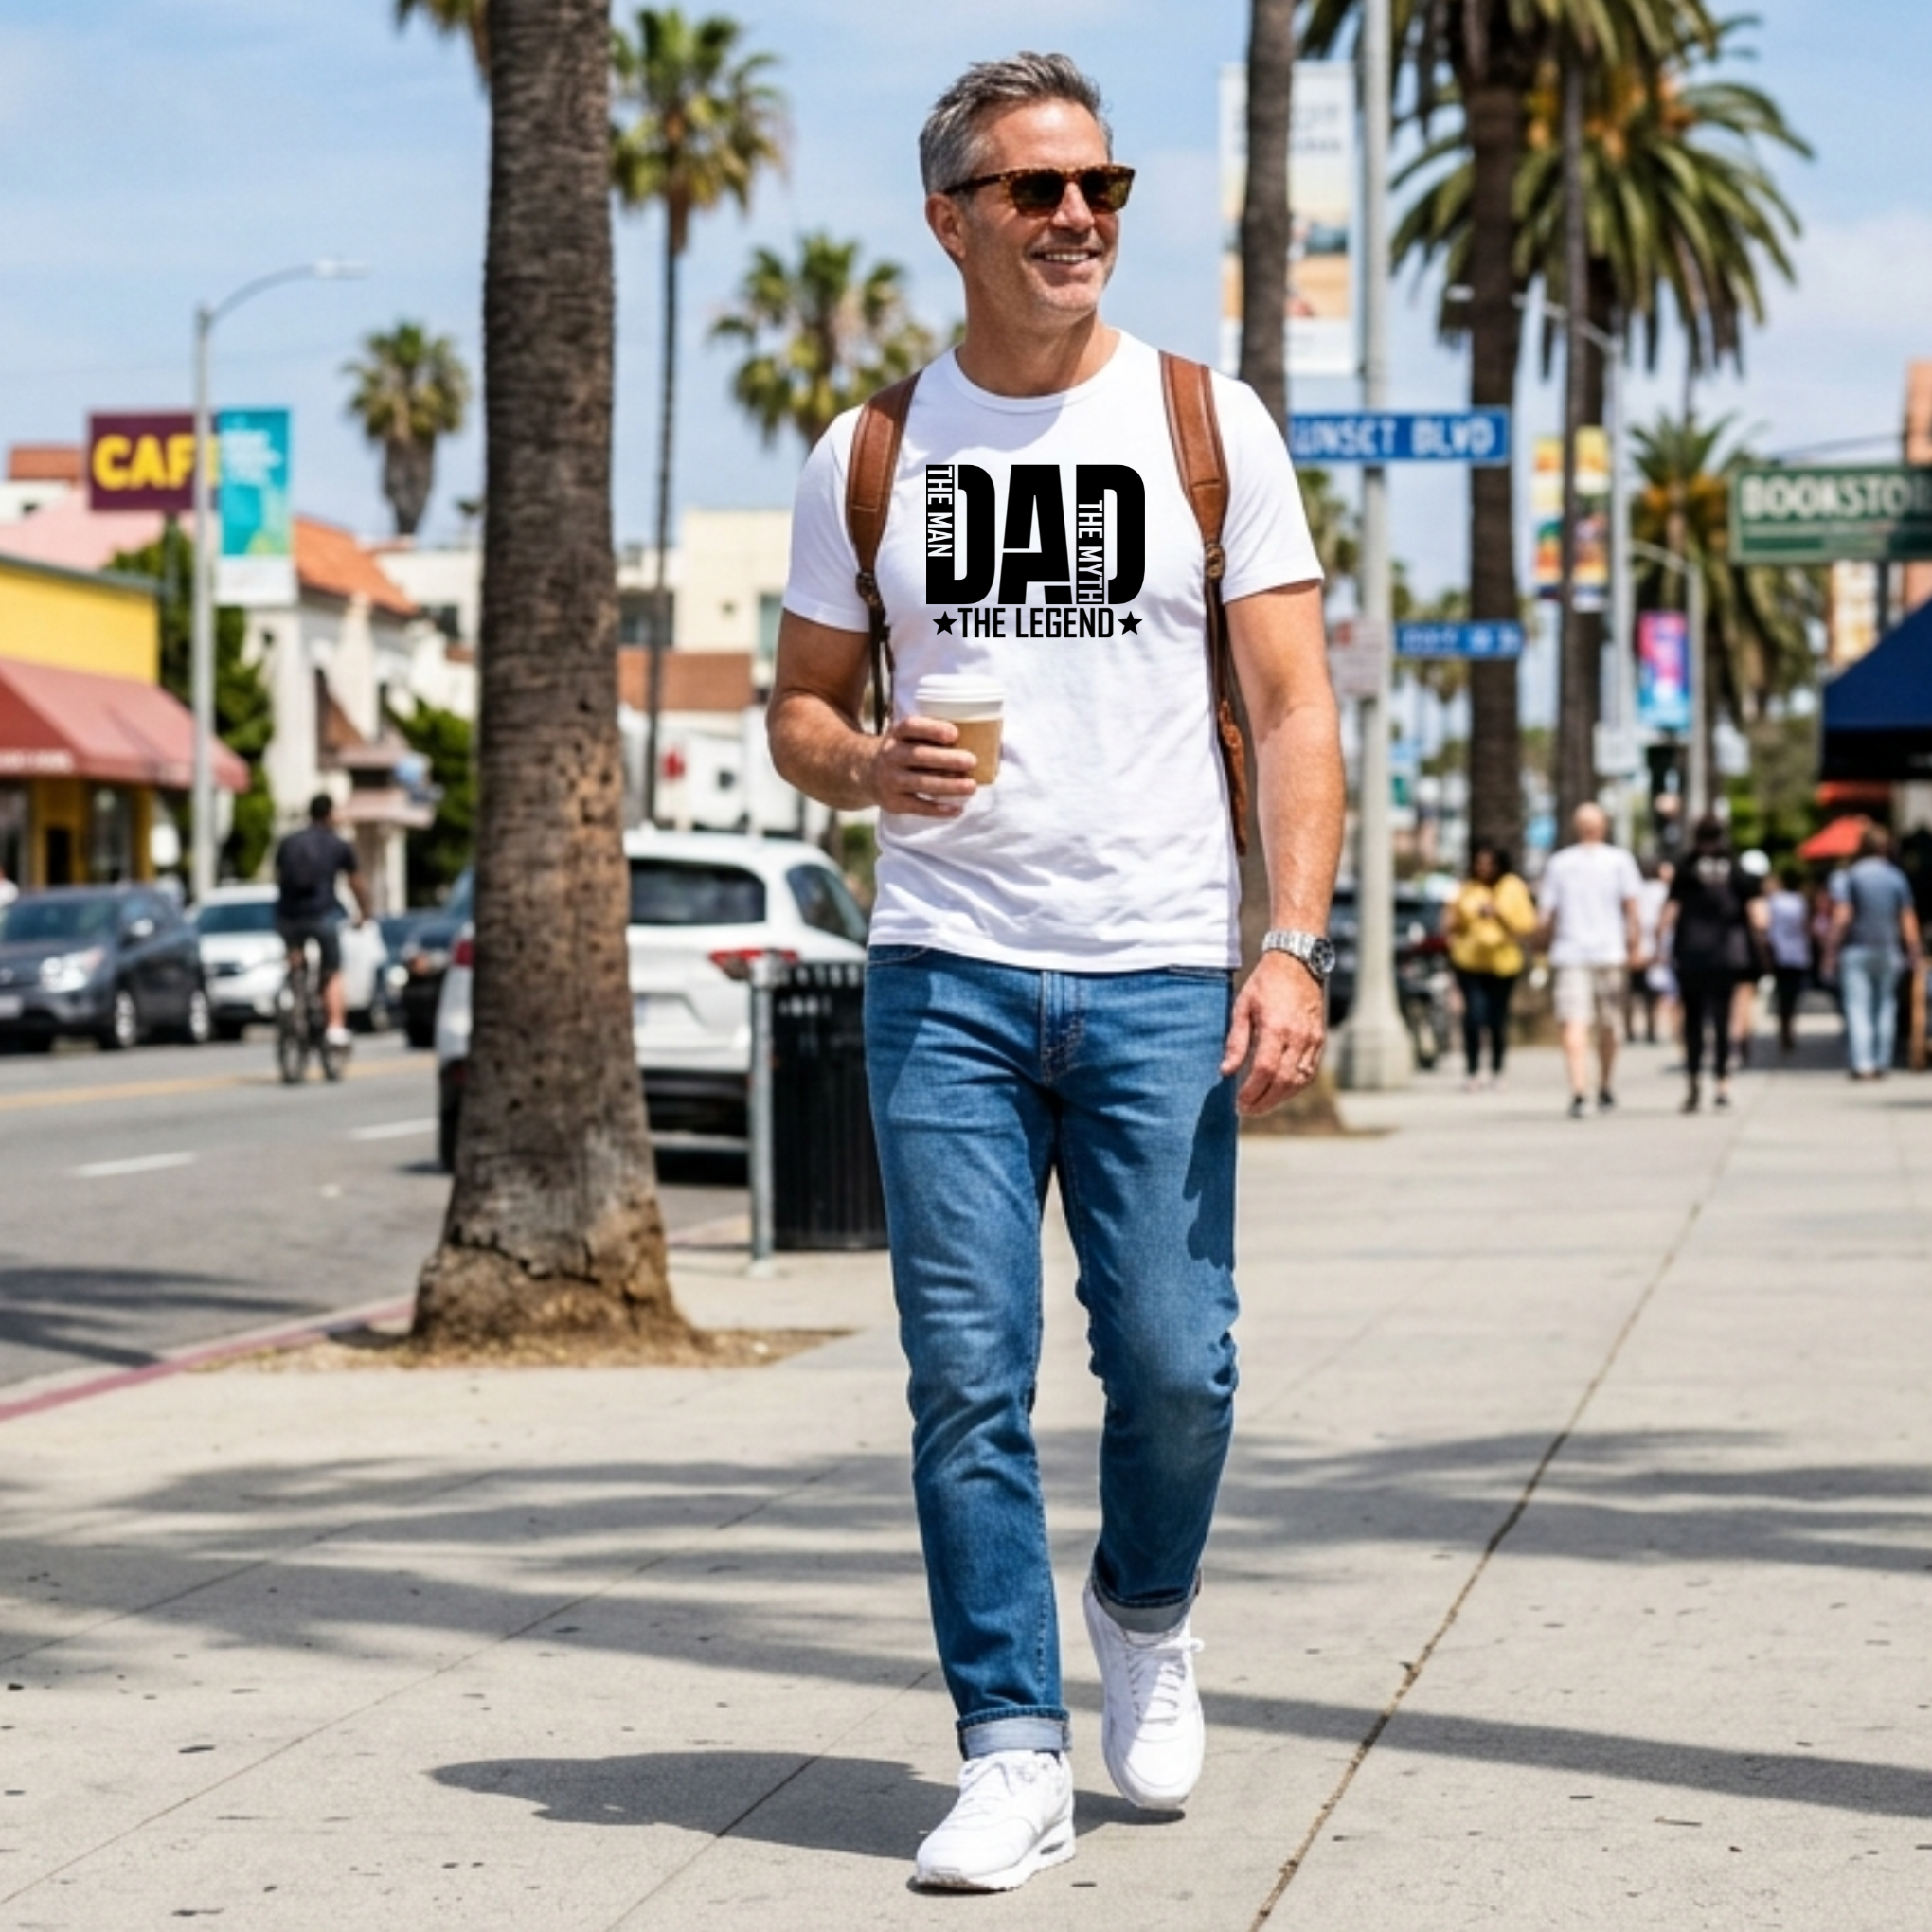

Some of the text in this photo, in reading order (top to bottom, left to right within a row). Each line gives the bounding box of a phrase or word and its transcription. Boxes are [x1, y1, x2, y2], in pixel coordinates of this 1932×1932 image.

[1411, 417, 1495, 456] BLVD
[926, 464, 1145, 604] DAD
[927, 466, 953, 557] THE MAN
[1078, 500, 1103, 602] THE MYTH
[957, 607, 1114, 638] THE LEGEND
